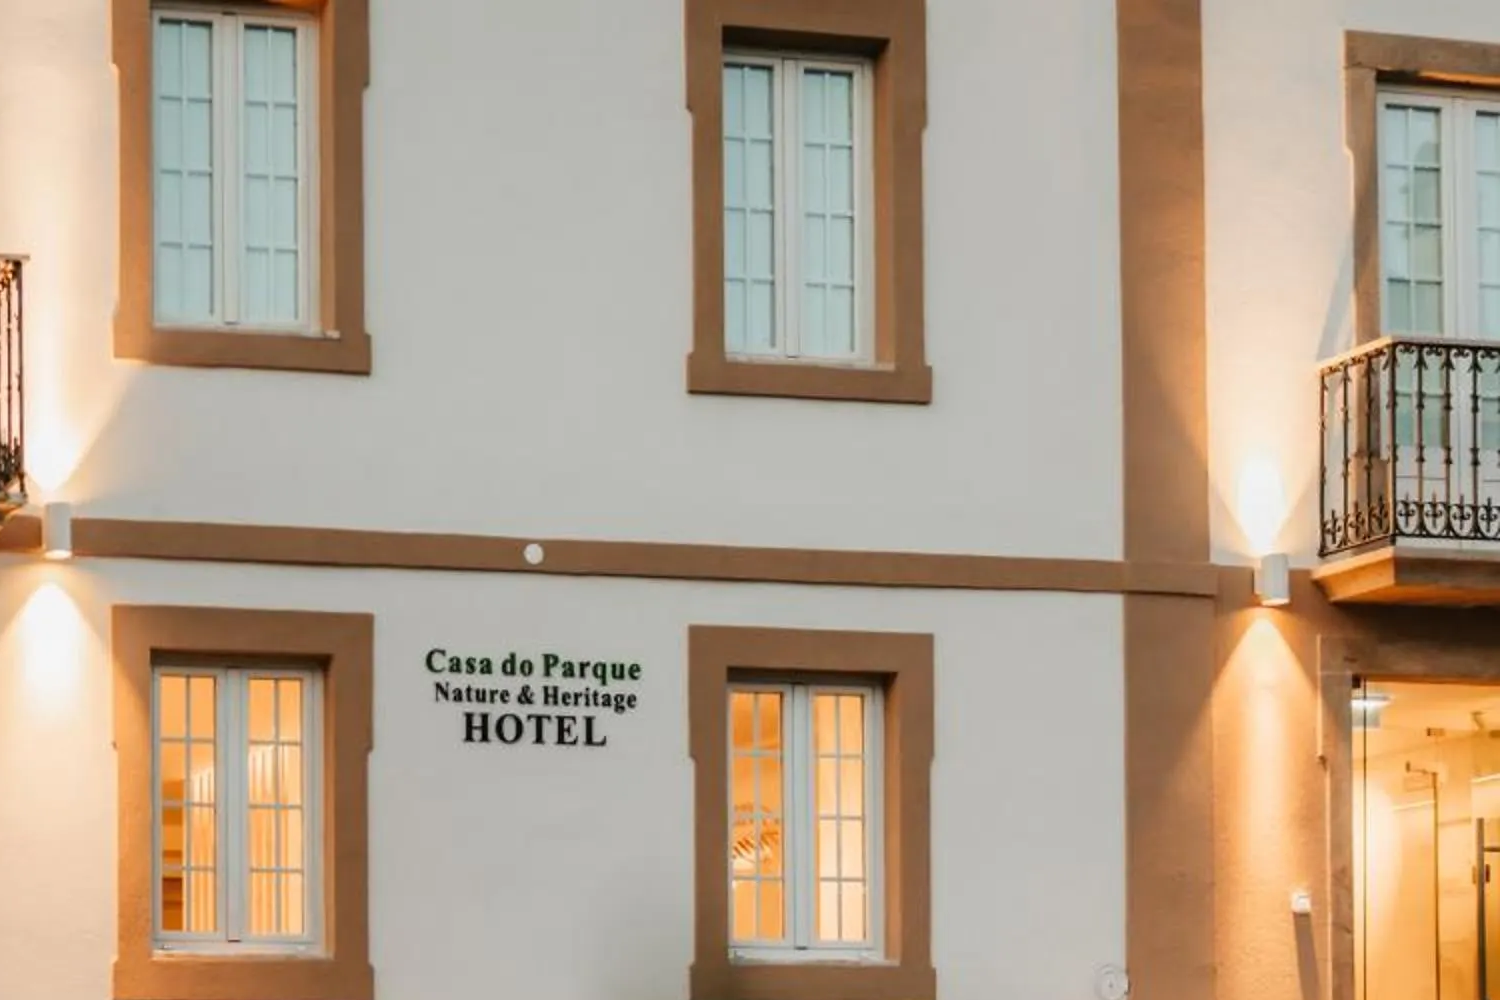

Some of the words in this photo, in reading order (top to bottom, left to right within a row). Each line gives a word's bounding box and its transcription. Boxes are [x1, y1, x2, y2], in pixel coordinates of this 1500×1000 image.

[425, 648, 493, 676] Casa
[501, 652, 535, 678] do
[542, 653, 642, 687] Parque
[434, 681, 511, 705] Nature
[516, 684, 535, 706] &
[542, 685, 637, 715] Heritage
[462, 711, 607, 747] HOTEL
